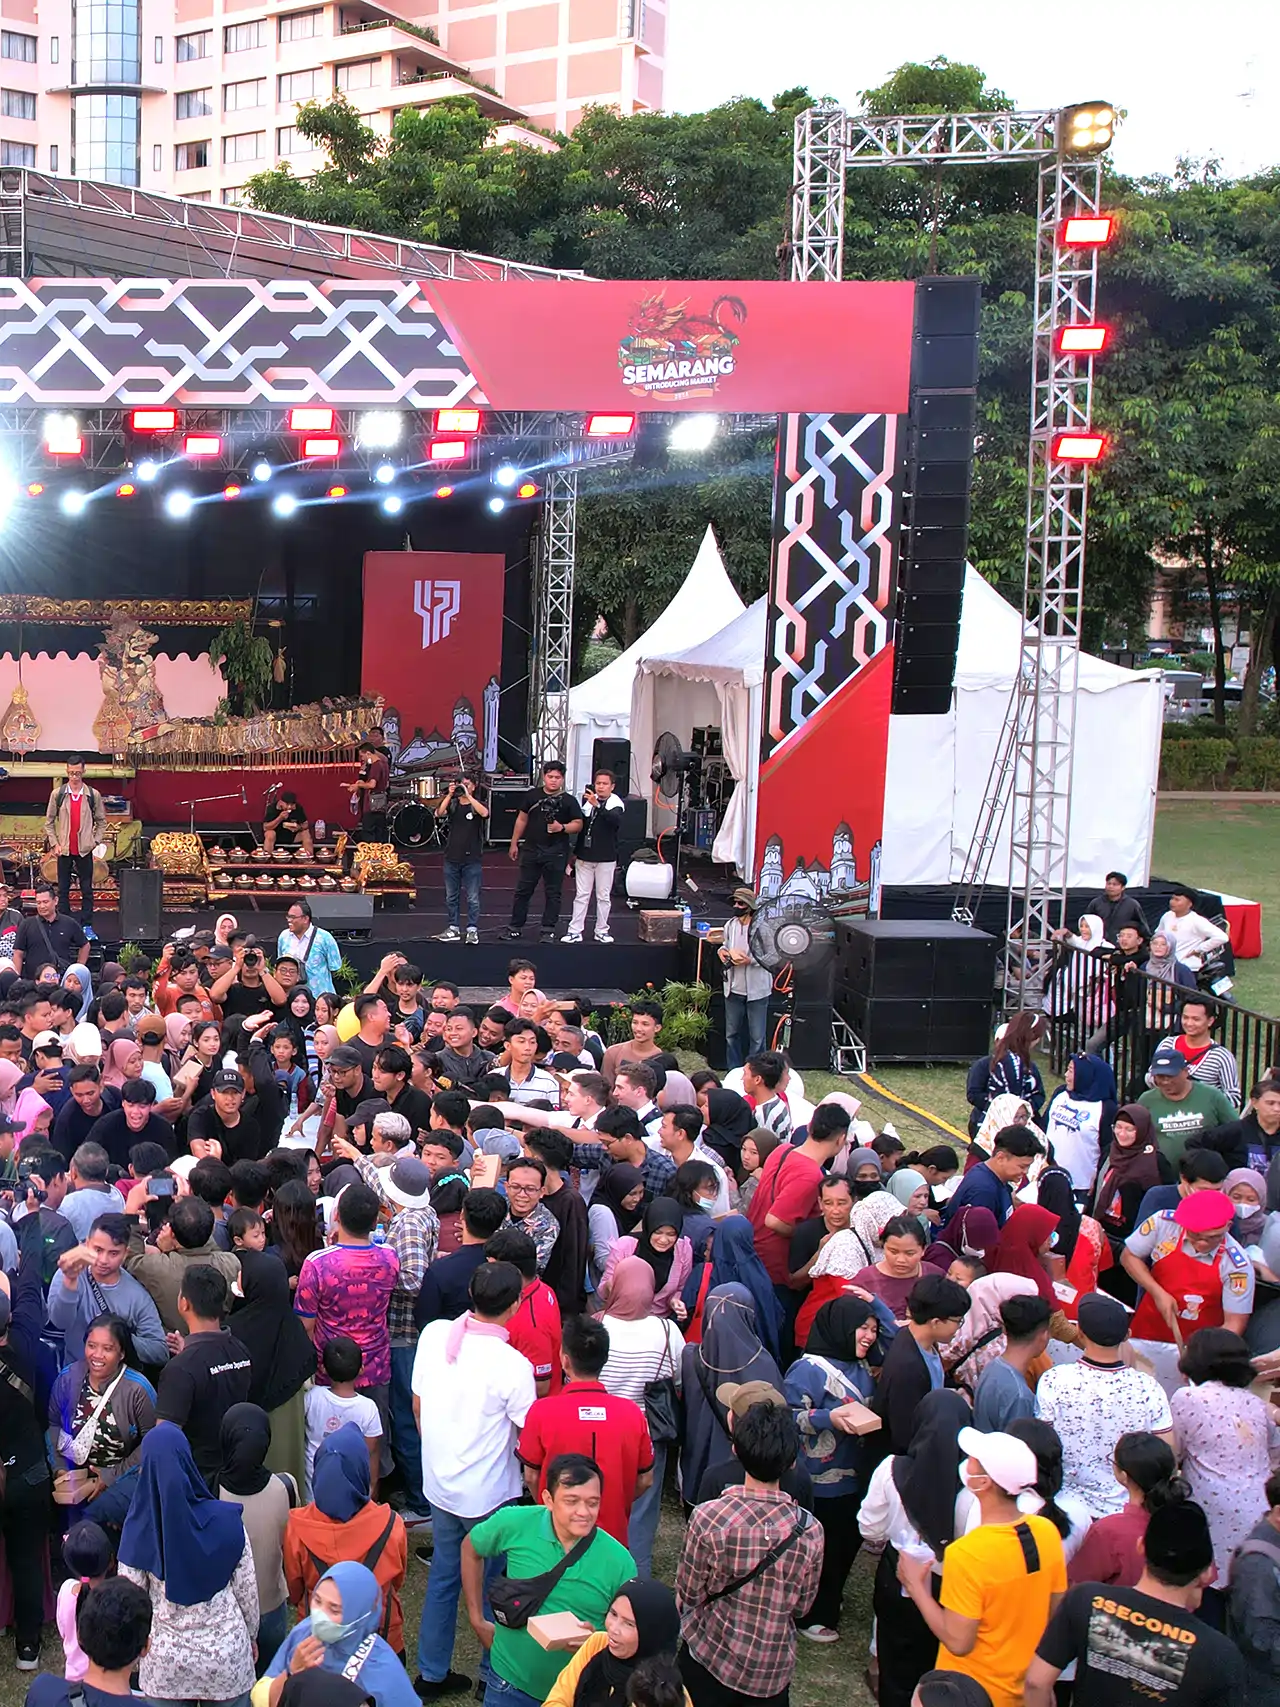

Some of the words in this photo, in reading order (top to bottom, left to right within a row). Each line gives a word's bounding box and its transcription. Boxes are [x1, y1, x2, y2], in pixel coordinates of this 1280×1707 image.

[622, 356, 734, 384] SEMARANG
[644, 379, 689, 391] INTRODUCING
[690, 376, 717, 386] MARKET
[1162, 1119, 1201, 1130] BUDAPEST
[1091, 1595, 1197, 1645] 3SECOND
